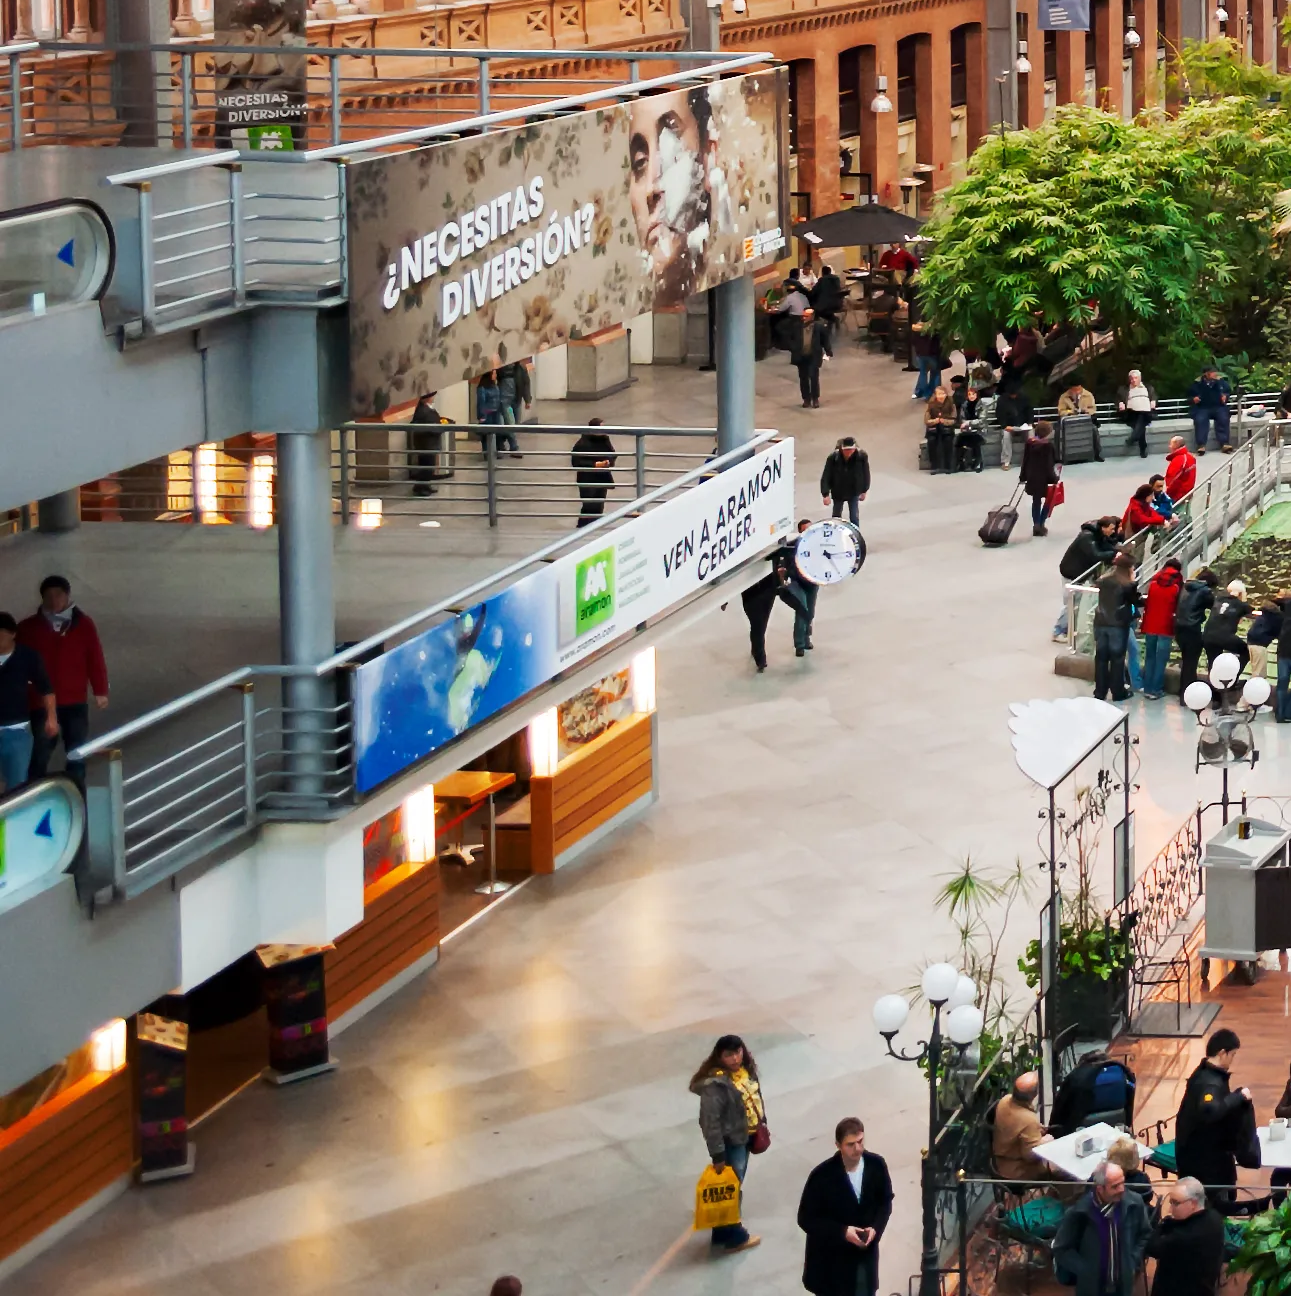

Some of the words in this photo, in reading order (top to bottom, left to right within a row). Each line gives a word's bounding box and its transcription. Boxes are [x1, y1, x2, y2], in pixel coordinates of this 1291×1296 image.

[383, 175, 544, 309] ¿NECESITAS
[442, 202, 595, 328] DIVERSIÓN?
[663, 529, 695, 579] VEN
[699, 518, 710, 544] A
[716, 453, 784, 535] ARAMÓN
[697, 513, 756, 581] CERLER.
